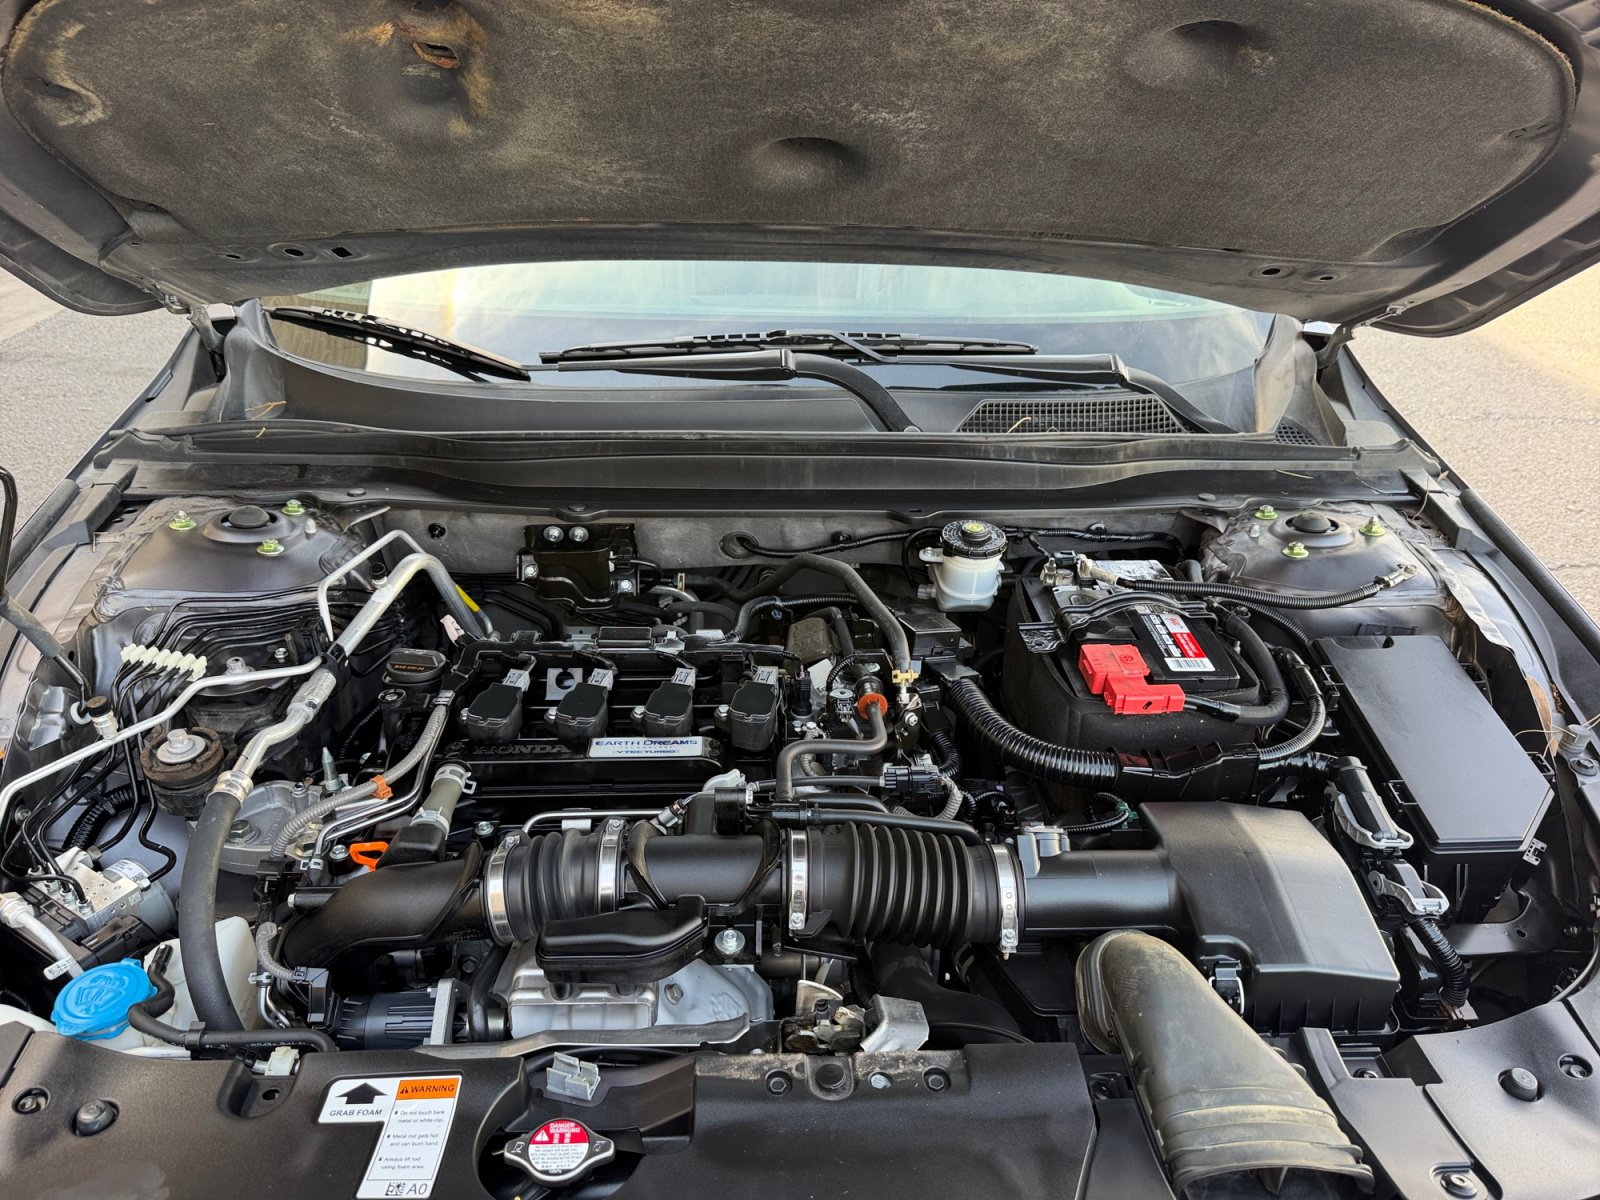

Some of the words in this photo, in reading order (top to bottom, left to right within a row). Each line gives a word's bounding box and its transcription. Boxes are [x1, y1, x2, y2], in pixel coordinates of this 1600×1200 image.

[473, 744, 571, 755] HONDA
[411, 1085, 455, 1093] WARNING
[329, 1109, 355, 1117] GRAB
[406, 1183, 428, 1195] A0
